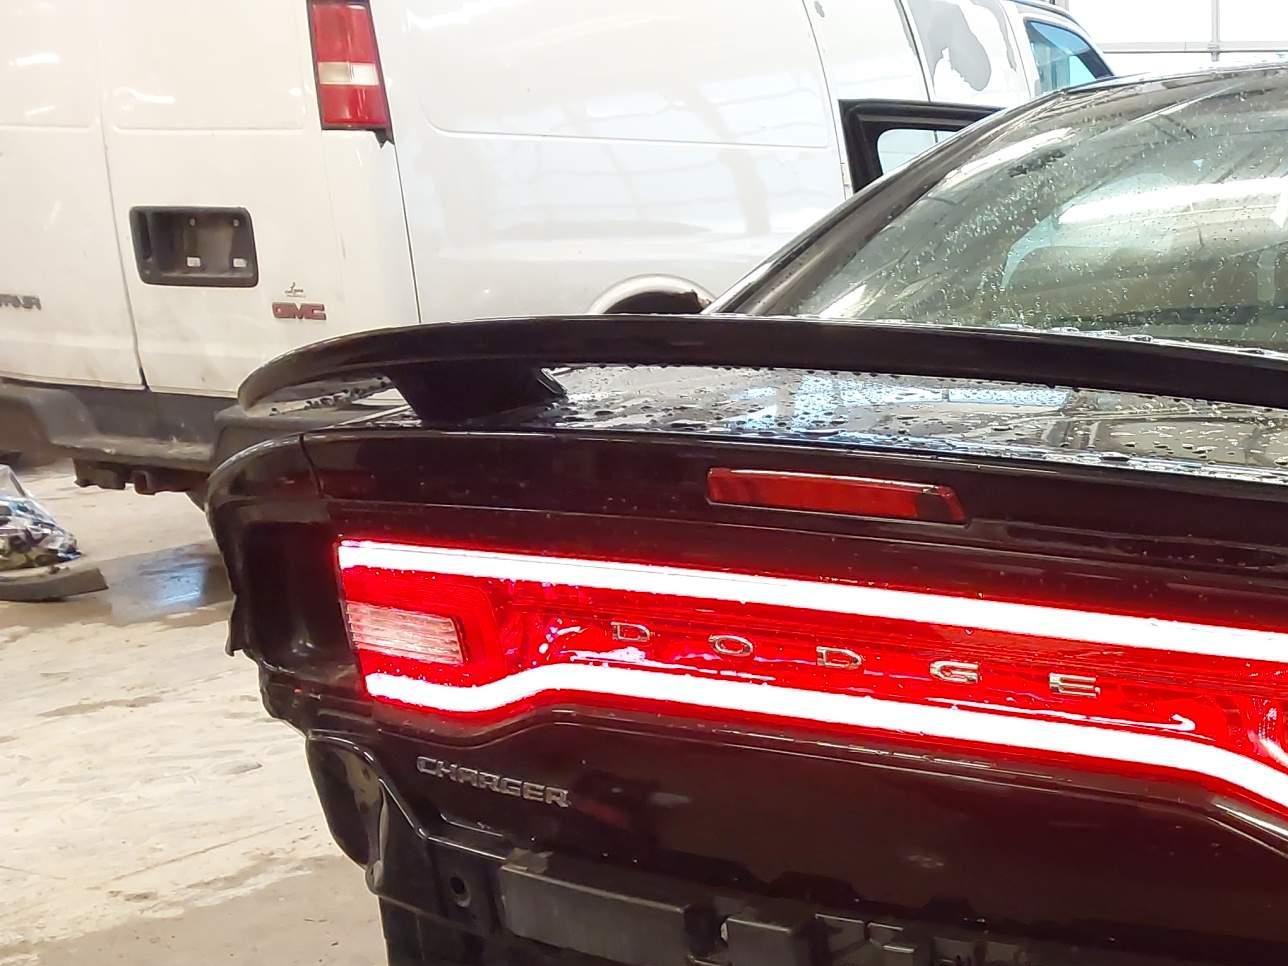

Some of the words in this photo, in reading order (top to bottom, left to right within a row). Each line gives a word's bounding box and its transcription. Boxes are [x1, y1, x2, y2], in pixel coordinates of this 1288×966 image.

[272, 302, 327, 320] GMC
[610, 621, 1101, 698] DODGE
[416, 756, 570, 807] CHARGER
